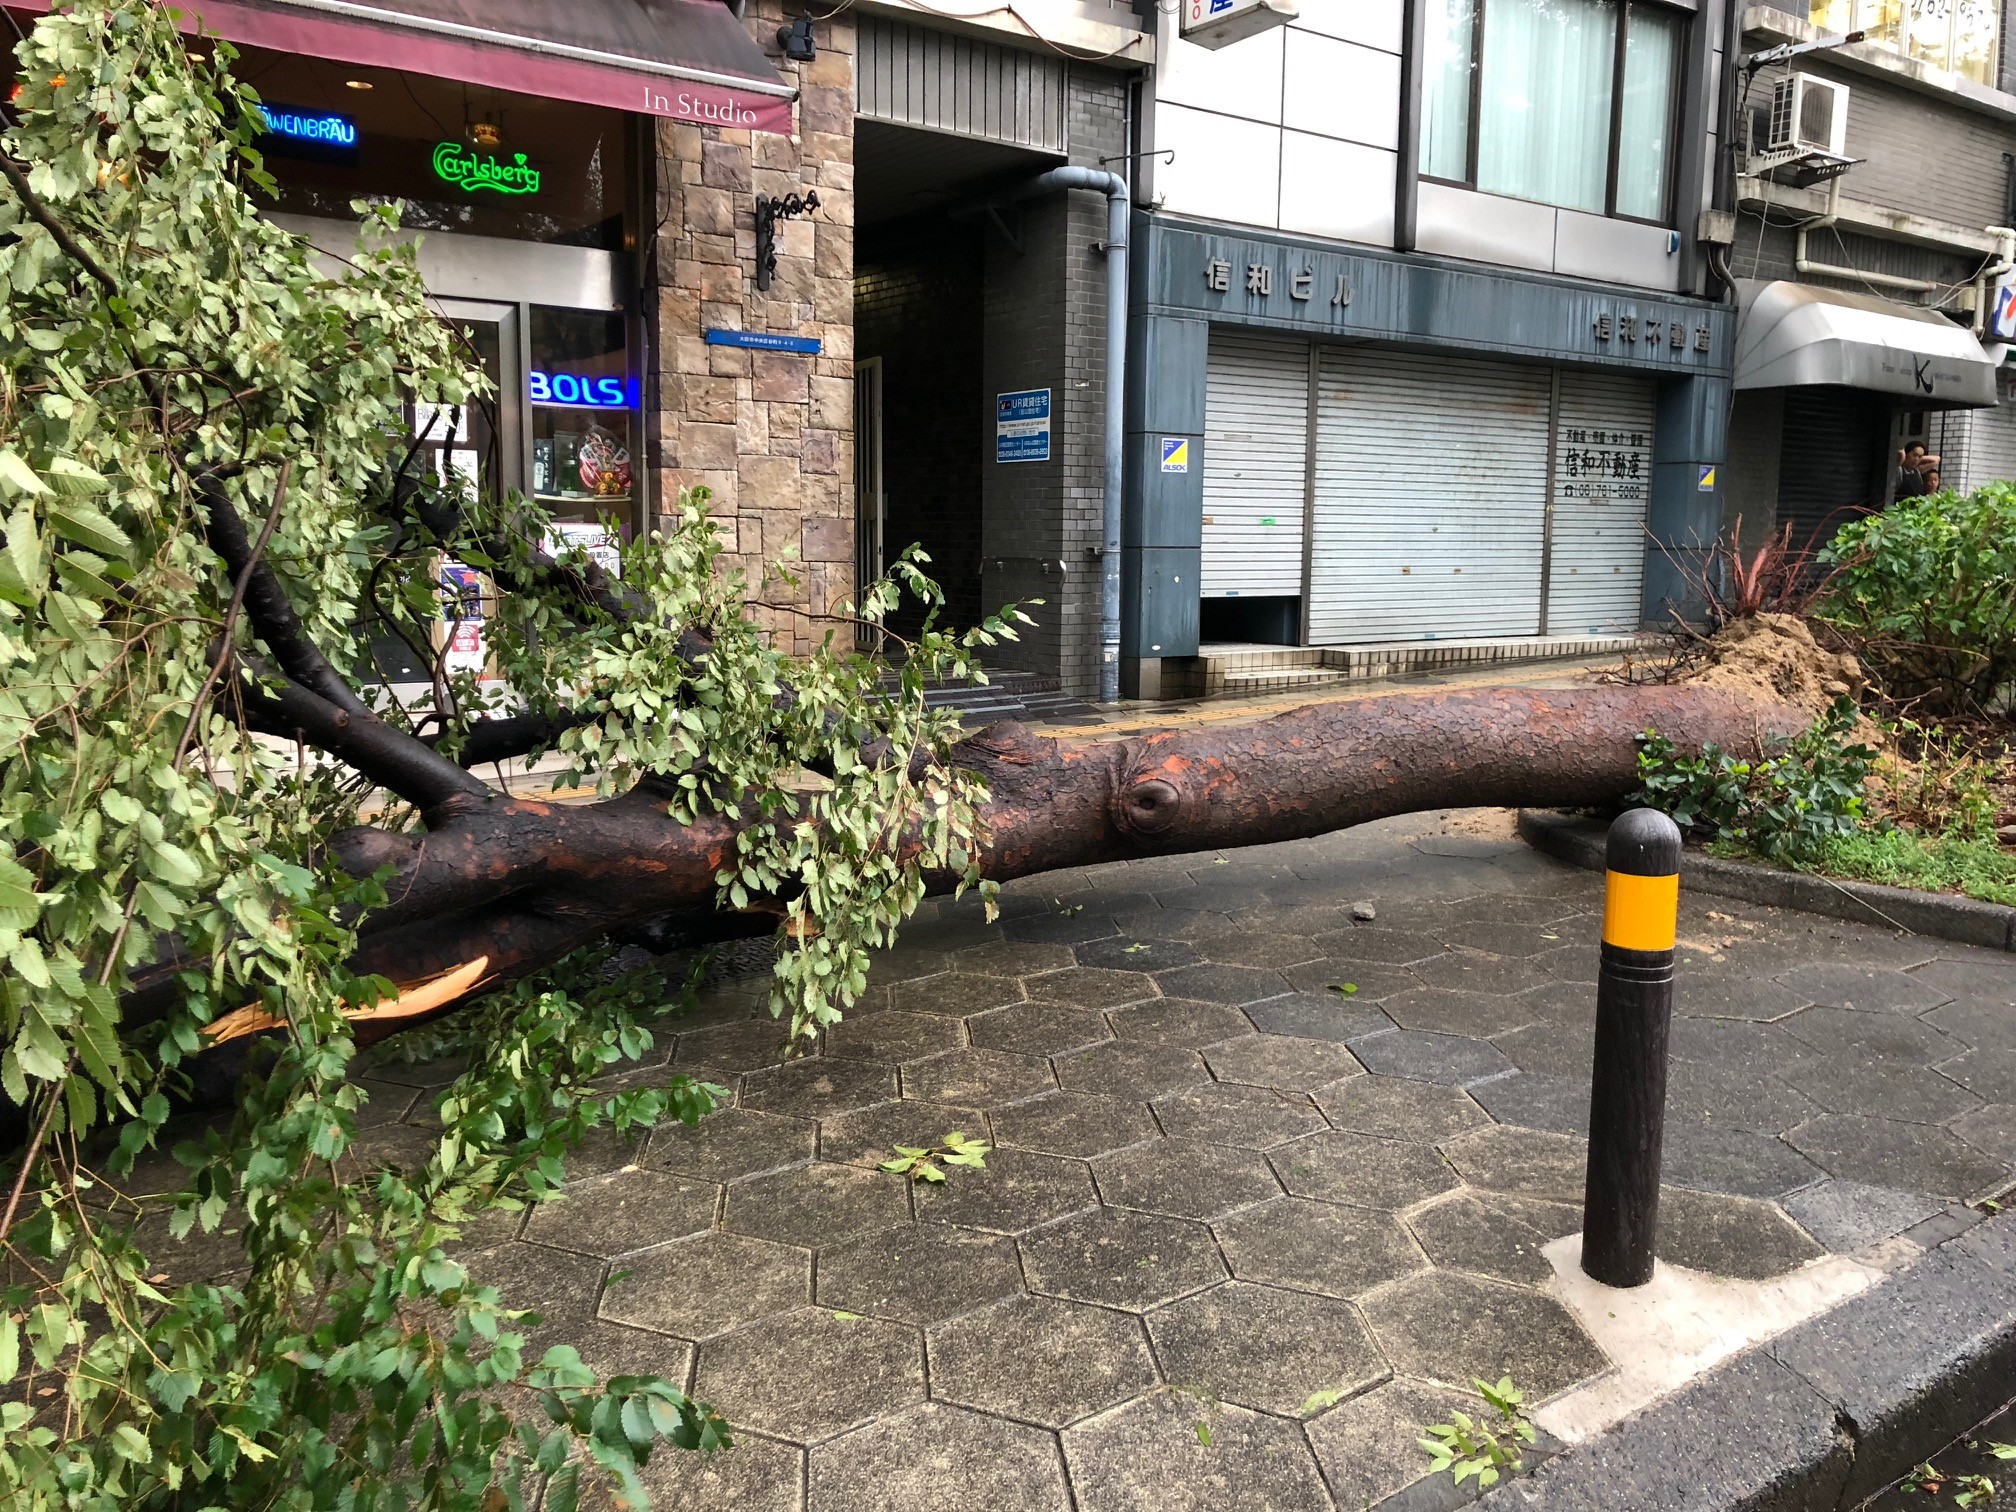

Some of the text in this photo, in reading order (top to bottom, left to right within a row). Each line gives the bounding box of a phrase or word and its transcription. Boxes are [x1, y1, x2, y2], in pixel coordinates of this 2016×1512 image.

[643, 86, 757, 124] In Studio
[432, 142, 541, 193] Carlsberg
[1205, 256, 1356, 307] 信和ビル
[1593, 312, 1711, 352] 信和不動産
[530, 371, 625, 405] BOLS
[1913, 353, 1934, 394] K
[1565, 447, 1641, 480] 信和不動産
